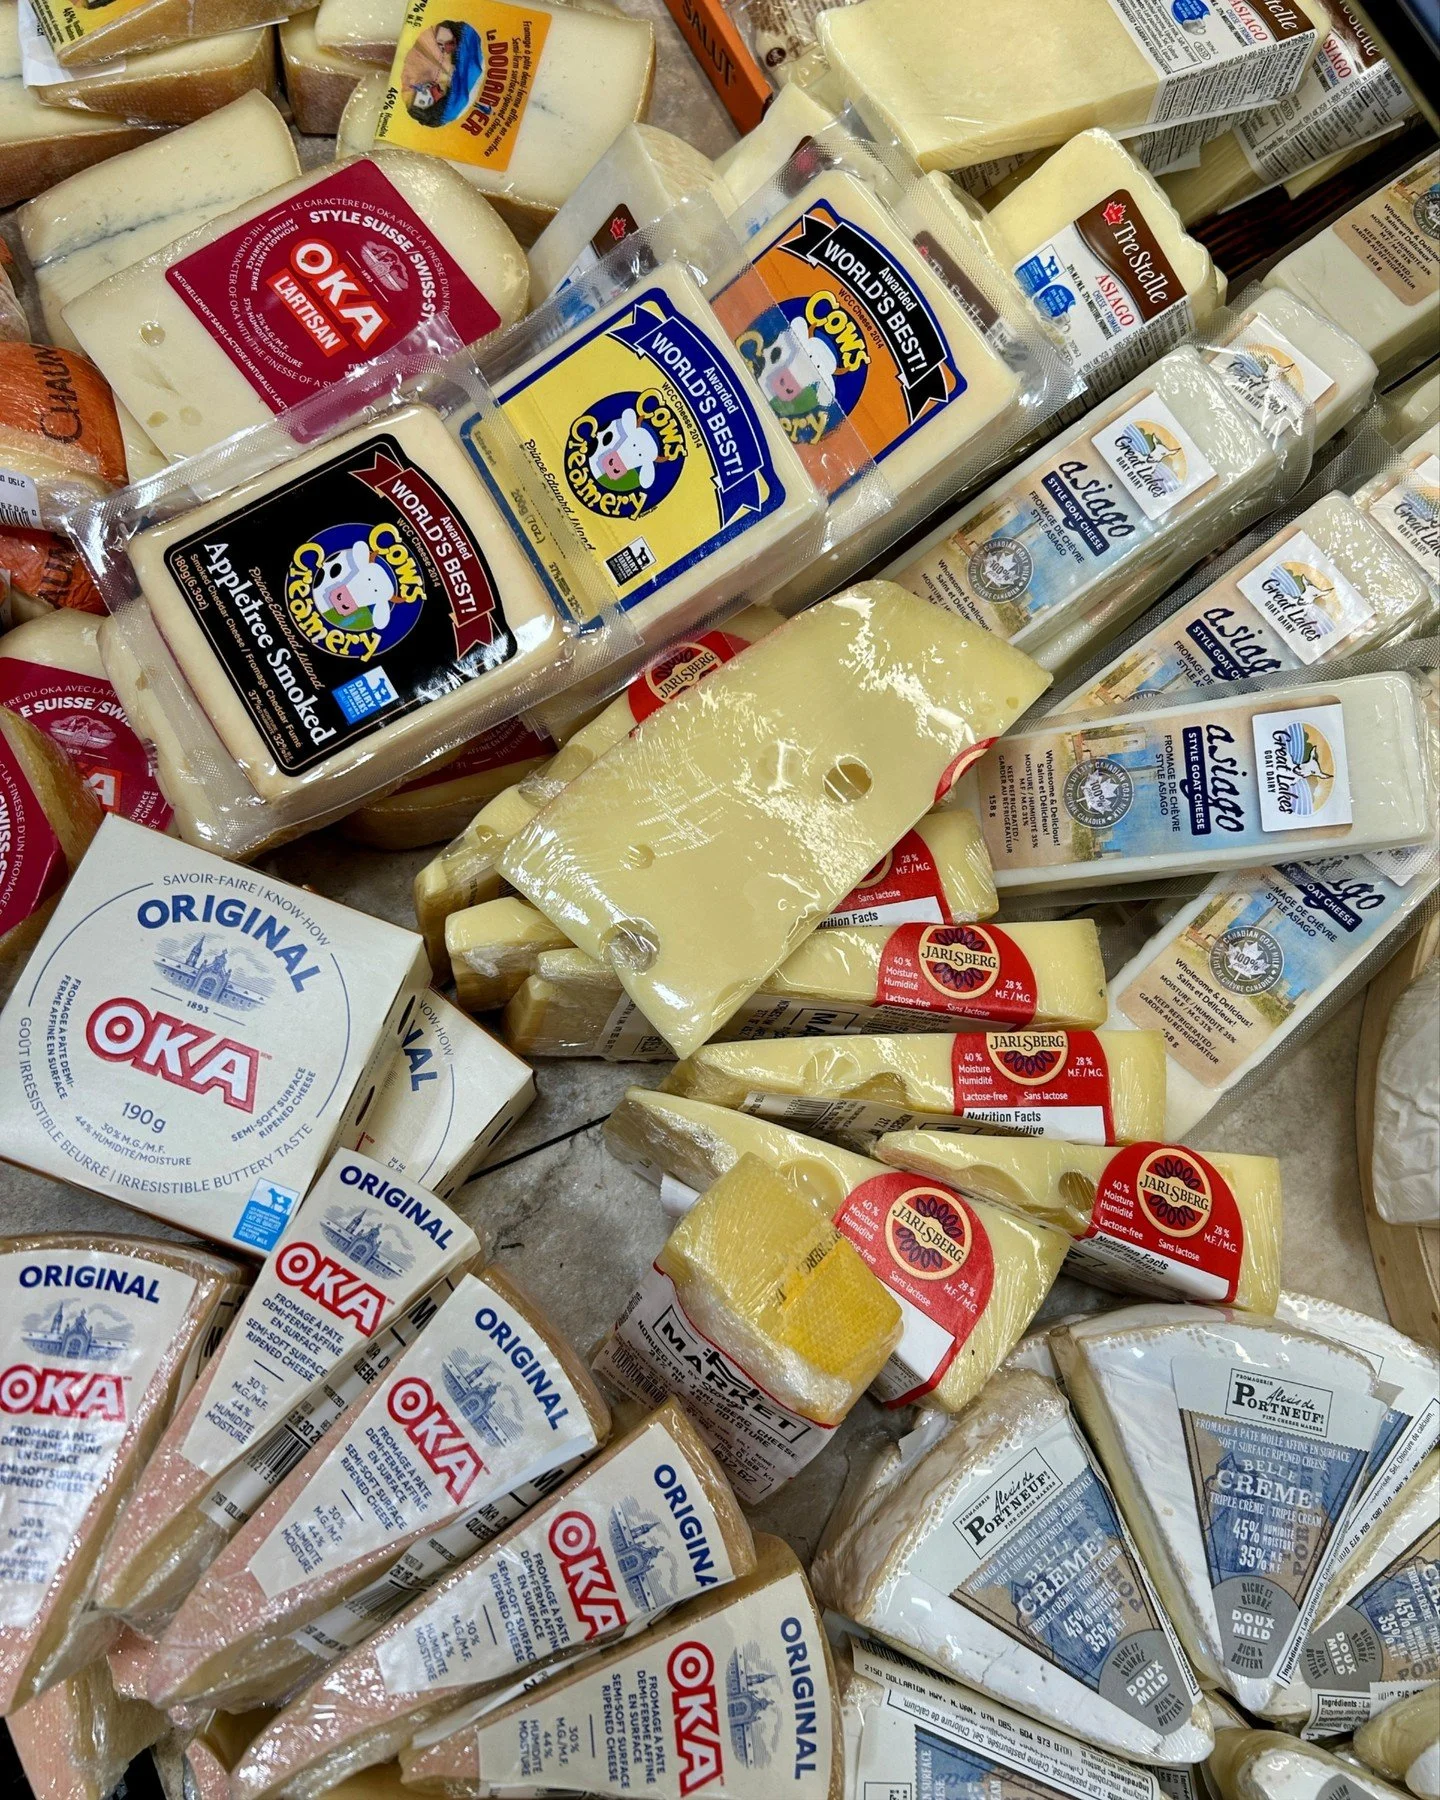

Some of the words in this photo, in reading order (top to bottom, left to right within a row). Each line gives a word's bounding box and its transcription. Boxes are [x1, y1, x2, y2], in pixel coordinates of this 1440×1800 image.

[486, 29, 497, 40] Le
[682, 3, 734, 87] SALUT
[383, 87, 398, 110] 46%
[495, 71, 519, 120] surface-ripened
[309, 210, 362, 225] STYLE
[396, 219, 419, 237] AVEC
[1384, 203, 1415, 235] Wholesome
[229, 237, 252, 285] CHARACTER
[291, 238, 390, 351] OKA
[824, 240, 896, 315] WORLD'S
[886, 310, 928, 373] BEST!
[878, 266, 918, 312] Awarded
[1096, 274, 1135, 327] ASIAGO
[275, 276, 341, 350] L'ARTISAN
[805, 290, 872, 373] Cows
[264, 356, 298, 379] FINESSE
[650, 332, 717, 412] WORLD'S
[706, 410, 744, 478] BEST!
[703, 366, 740, 415] Awarded
[636, 387, 689, 463] Cows
[674, 397, 697, 430] Cheese
[689, 427, 703, 449] 2014
[567, 415, 649, 521] Creamery
[1115, 456, 1129, 473] GOAT
[1029, 490, 1057, 527] FROMAGE
[1046, 476, 1067, 502] STYLE
[1064, 500, 1084, 525] GOAT
[1081, 522, 1104, 551] CHEESE
[1058, 460, 1136, 538] asiago
[390, 479, 453, 555] WORLD'S
[445, 552, 479, 614] BEST!
[439, 514, 473, 560] Awarded
[1030, 509, 1047, 530] STYLE
[1045, 530, 1066, 556] ASIAGO
[368, 522, 427, 604] Cows
[287, 542, 382, 663] Creamery
[1263, 601, 1278, 618] GOAT
[1276, 616, 1297, 635] DAIRY
[190, 553, 211, 587] Smoked
[207, 586, 229, 619] Cheddar
[226, 618, 246, 649] Cheese
[245, 653, 269, 690] Fromage
[266, 688, 289, 725] Cheddar
[204, 542, 274, 649] Appletree
[267, 647, 337, 746] Smoked
[658, 650, 718, 699] JARLSBERG
[1155, 753, 1165, 775] STYLE
[1164, 734, 1176, 782] FROMAGE
[1188, 732, 1198, 762] STYLE
[1264, 750, 1274, 769] GOAT
[1272, 730, 1292, 772] Great
[1024, 753, 1034, 789] MOISTURE
[1045, 749, 1056, 798] Wholesome
[1191, 765, 1202, 790] GOAT
[1206, 724, 1247, 832] asiago
[1266, 771, 1276, 793] DAIRY
[1156, 778, 1169, 816] ASIAGO
[1169, 793, 1181, 832] CHÈVRE
[1194, 794, 1205, 830] CHEESE
[1276, 774, 1299, 815] Lakes
[163, 873, 259, 895] SAVOIR-FAIRE
[264, 888, 332, 948] KNOW-HOW
[136, 893, 322, 994] ORIGINAL
[921, 944, 998, 970] JARLSBERG
[1222, 930, 1259, 944] CANADIAN
[52, 974, 71, 1006] FERME
[883, 977, 919, 991] Humidité
[885, 965, 919, 980] Moisture
[1175, 958, 1213, 995] Wholesome
[1219, 998, 1254, 1029] Delicious!
[62, 978, 81, 1025] FROMAGE
[186, 1000, 210, 1015] 1893
[885, 992, 931, 1009] Lactose-free
[1139, 992, 1165, 1018] GARDER
[85, 997, 260, 1115] OKA
[989, 1034, 1067, 1052] JARLSBERG
[48, 1059, 68, 1100] SURFACE
[958, 1063, 991, 1074] Moisture
[231, 1105, 278, 1142] SEMI-SOFT
[277, 1067, 306, 1107] SURFACE
[259, 1105, 294, 1138] RIPENED
[293, 1071, 316, 1105] CHEESE
[961, 1091, 1008, 1102] Lactose-free
[1042, 1090, 1069, 1101] lactose
[116, 1173, 210, 1195] IRRESISTIBLE
[212, 1154, 276, 1189] BUTTERY
[271, 1122, 314, 1159] TASTE
[339, 1165, 456, 1251] ORIGINAL
[1100, 1200, 1134, 1220] Humidité
[1103, 1189, 1135, 1208] Moisture
[1139, 1173, 1210, 1212] JARLSBERG
[840, 1212, 875, 1243] Humidité
[847, 1203, 881, 1233] Moisture
[891, 1204, 964, 1263] JARLSBERG
[1099, 1216, 1144, 1240] Lactose-free
[1157, 1238, 1175, 1251] Sans
[1173, 1243, 1200, 1262] lactose
[18, 1264, 161, 1304] ORIGINAL
[275, 1242, 386, 1338] OKA
[245, 1318, 290, 1351] SEMI-SOFT
[286, 1343, 328, 1378] SURFACE
[245, 1332, 284, 1362] RIPENED
[282, 1354, 316, 1382] CHEESE
[474, 1307, 569, 1431] ORIGINAL
[0, 1364, 126, 1423] OKA
[204, 1411, 249, 1445] MOISTURE
[378, 1425, 412, 1470] FROMAGE
[387, 1376, 482, 1505] OKA
[757, 1429, 799, 1459] CHEESE
[1195, 1419, 1232, 1436] FROMAGE
[345, 1443, 380, 1489] SEMI-SOFT
[376, 1488, 407, 1530] SURFACE
[1217, 1469, 1313, 1509] CRÈME
[1242, 1459, 1297, 1483] BELLE
[340, 1457, 370, 1496] RIPENED
[367, 1495, 394, 1531] CHEESE
[1232, 1517, 1260, 1544] 45%
[548, 1511, 627, 1641] OKA
[1018, 1538, 1102, 1615] CRÈME
[1024, 1539, 1073, 1583] BELLE
[1237, 1544, 1267, 1571] 35%
[489, 1572, 510, 1620] RIPENED
[506, 1621, 525, 1663] CHEESE
[1063, 1608, 1093, 1640] 45%
[1085, 1621, 1116, 1654] 35%
[1231, 1608, 1276, 1630] DOUX
[1232, 1622, 1272, 1641] MILD
[1327, 1637, 1345, 1676] MILD
[1335, 1631, 1357, 1675] DOUX
[779, 1616, 818, 1780] ORIGINAL
[1125, 1660, 1164, 1698] DOUX
[1136, 1672, 1169, 1706] MILD
[602, 1685, 615, 1734] RIPENED
[612, 1674, 626, 1733] SEMI-SOFT
[649, 1676, 662, 1731] FROMAGE
[667, 1640, 723, 1799] OKA
[1157, 1700, 1185, 1727] BUTTERY
[519, 1720, 531, 1777] MOISTURE
[606, 1738, 619, 1782] CHEESE
[618, 1735, 630, 1789] SURFACE
